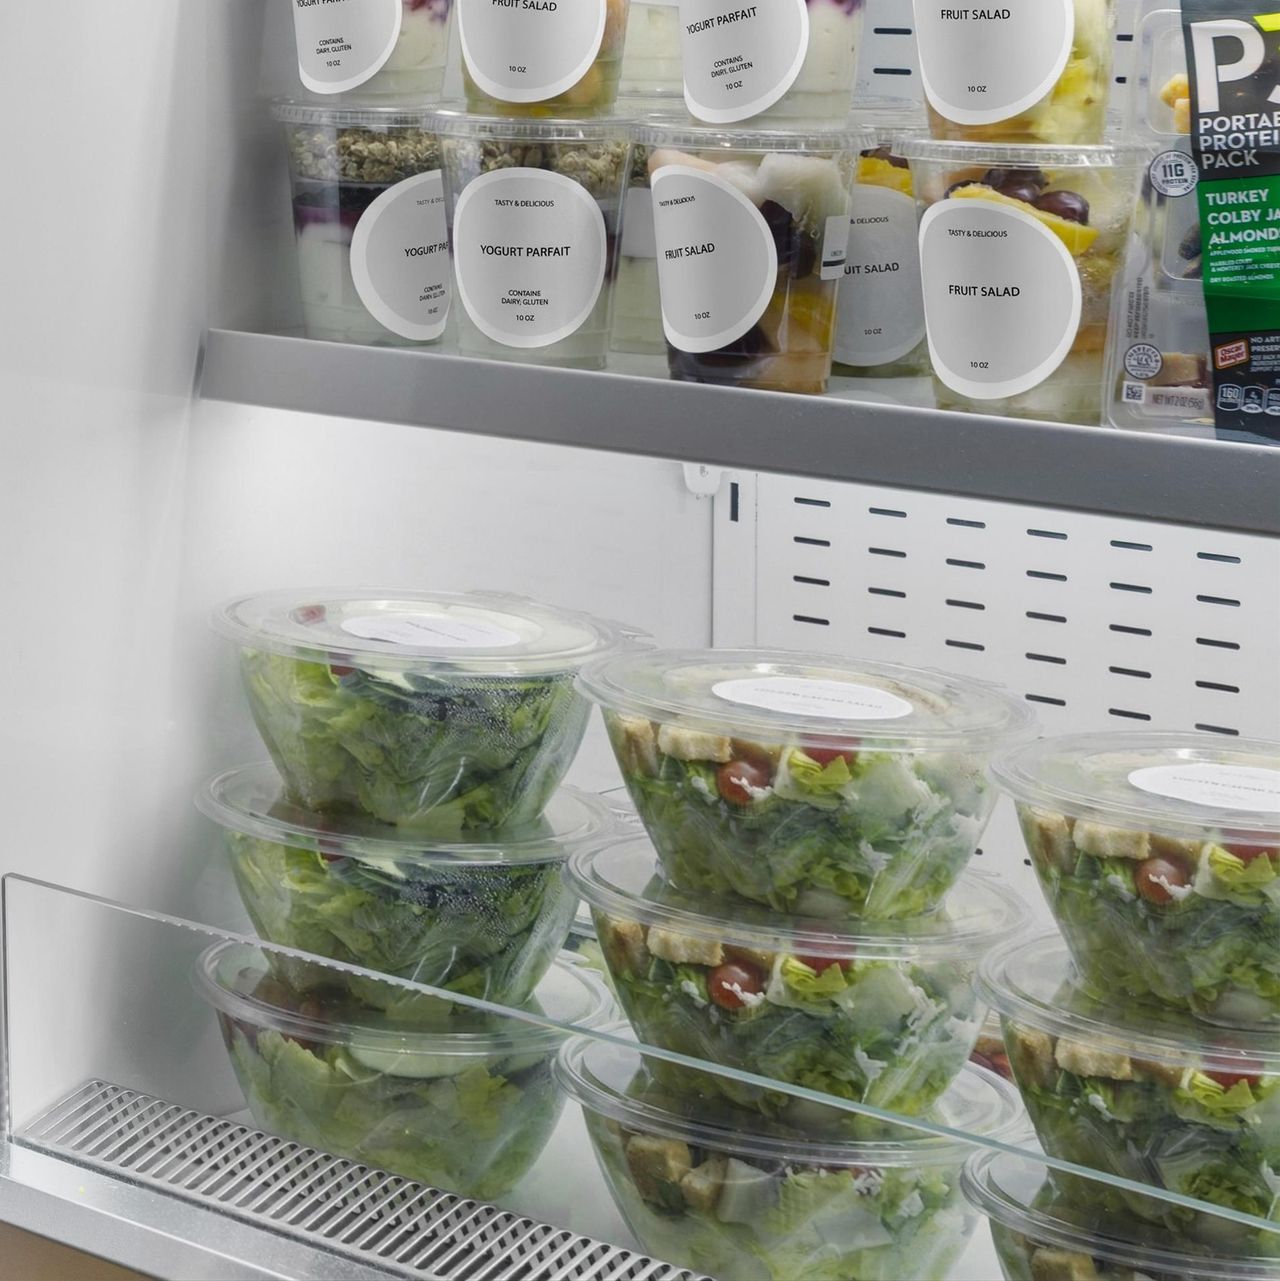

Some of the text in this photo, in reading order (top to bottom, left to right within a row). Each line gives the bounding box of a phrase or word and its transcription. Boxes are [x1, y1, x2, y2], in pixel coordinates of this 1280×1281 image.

[523, 0, 557, 12] SALAD
[686, 7, 757, 34] YOGURT PARFAIT
[941, 9, 1011, 20] FRUIT SALAD
[729, 62, 753, 74] GLUTEN
[1202, 150, 1259, 169] PACK
[1162, 164, 1185, 179] 11G
[1205, 189, 1269, 206] TURKEY
[1207, 210, 1261, 225] COLBY
[405, 245, 437, 256] YOGURT
[480, 245, 570, 256] YOGURT PARFAIT
[665, 243, 715, 260] FRUIT SALAD
[864, 262, 899, 274] SALAD
[949, 285, 1020, 297] FRUIT SALAD
